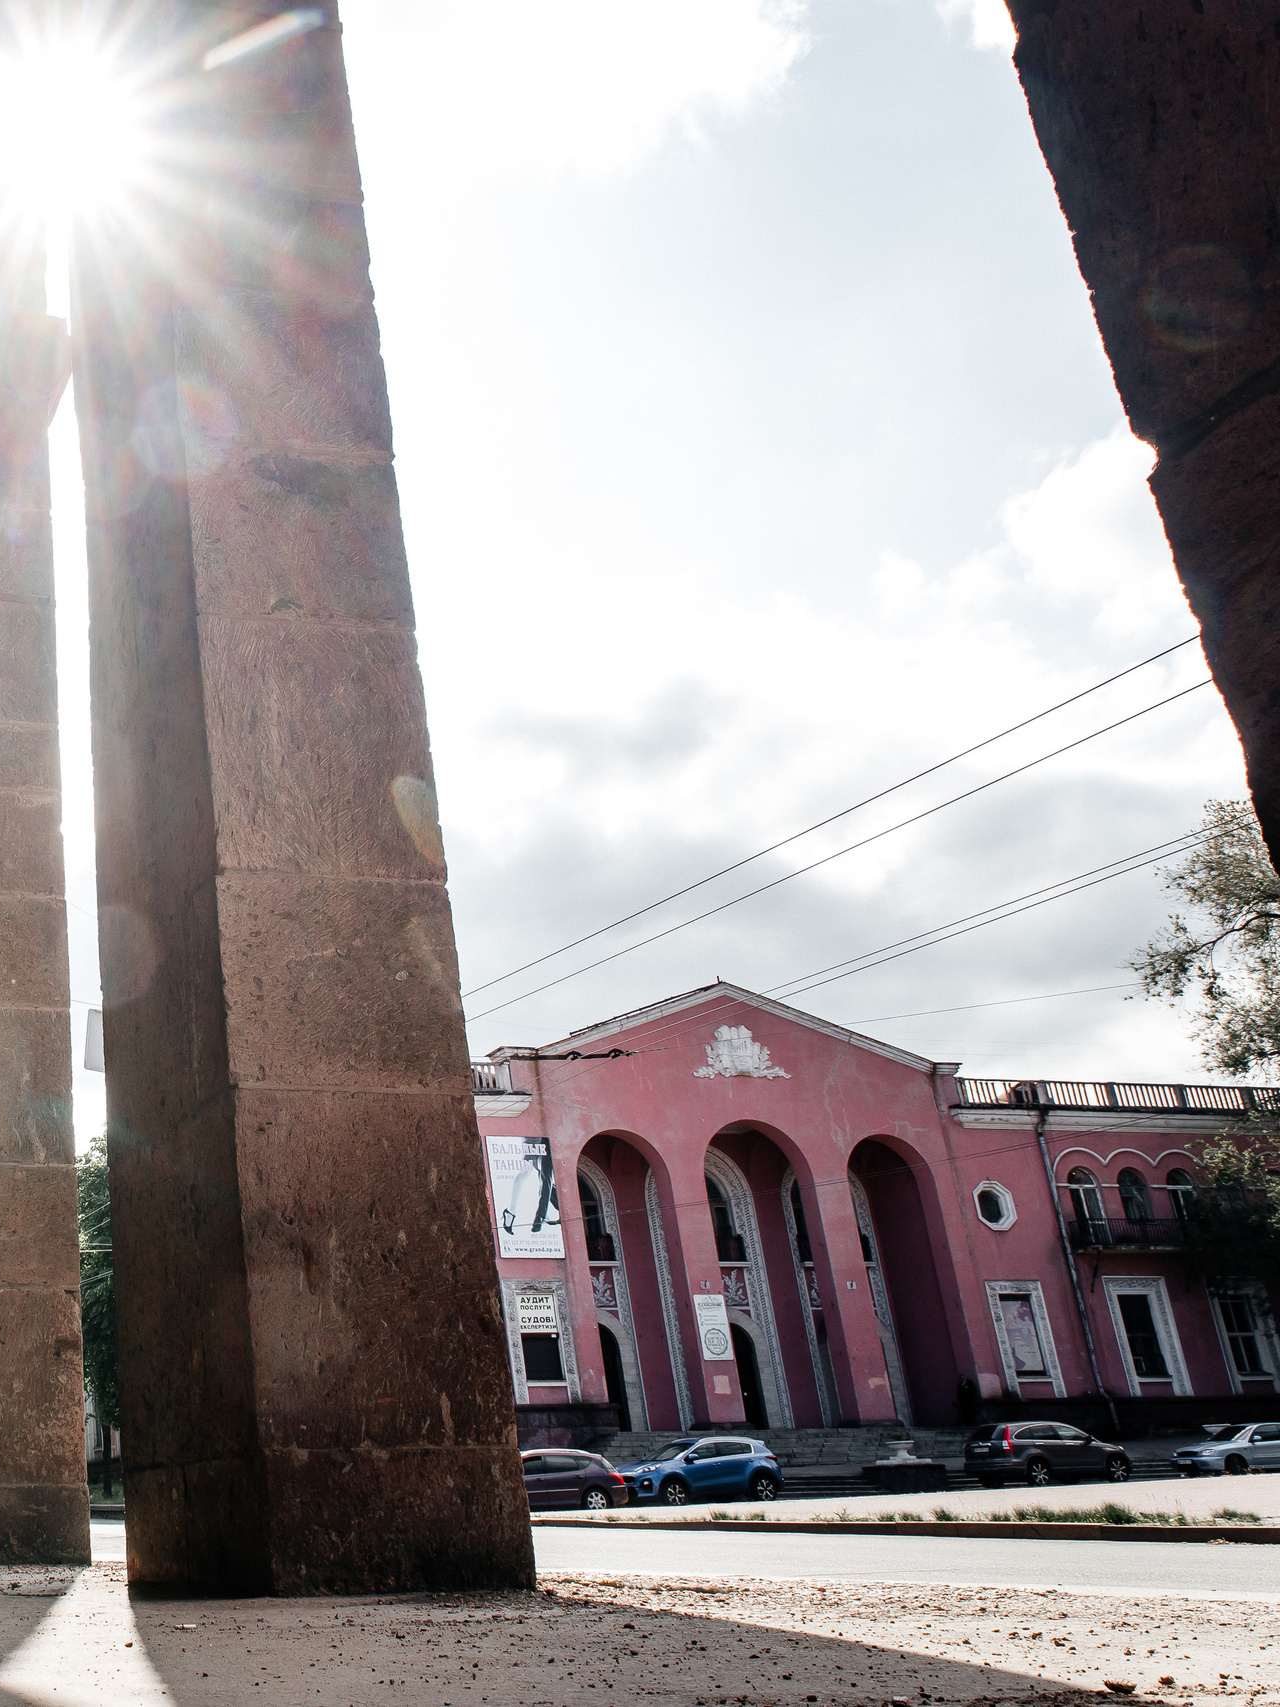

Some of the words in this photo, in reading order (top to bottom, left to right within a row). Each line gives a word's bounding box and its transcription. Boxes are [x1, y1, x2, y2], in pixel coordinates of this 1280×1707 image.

[494, 1159, 534, 1172] ТАНЦЫ
[520, 1296, 550, 1304] АУДИТ
[521, 1316, 554, 1324] СУДОВІ
